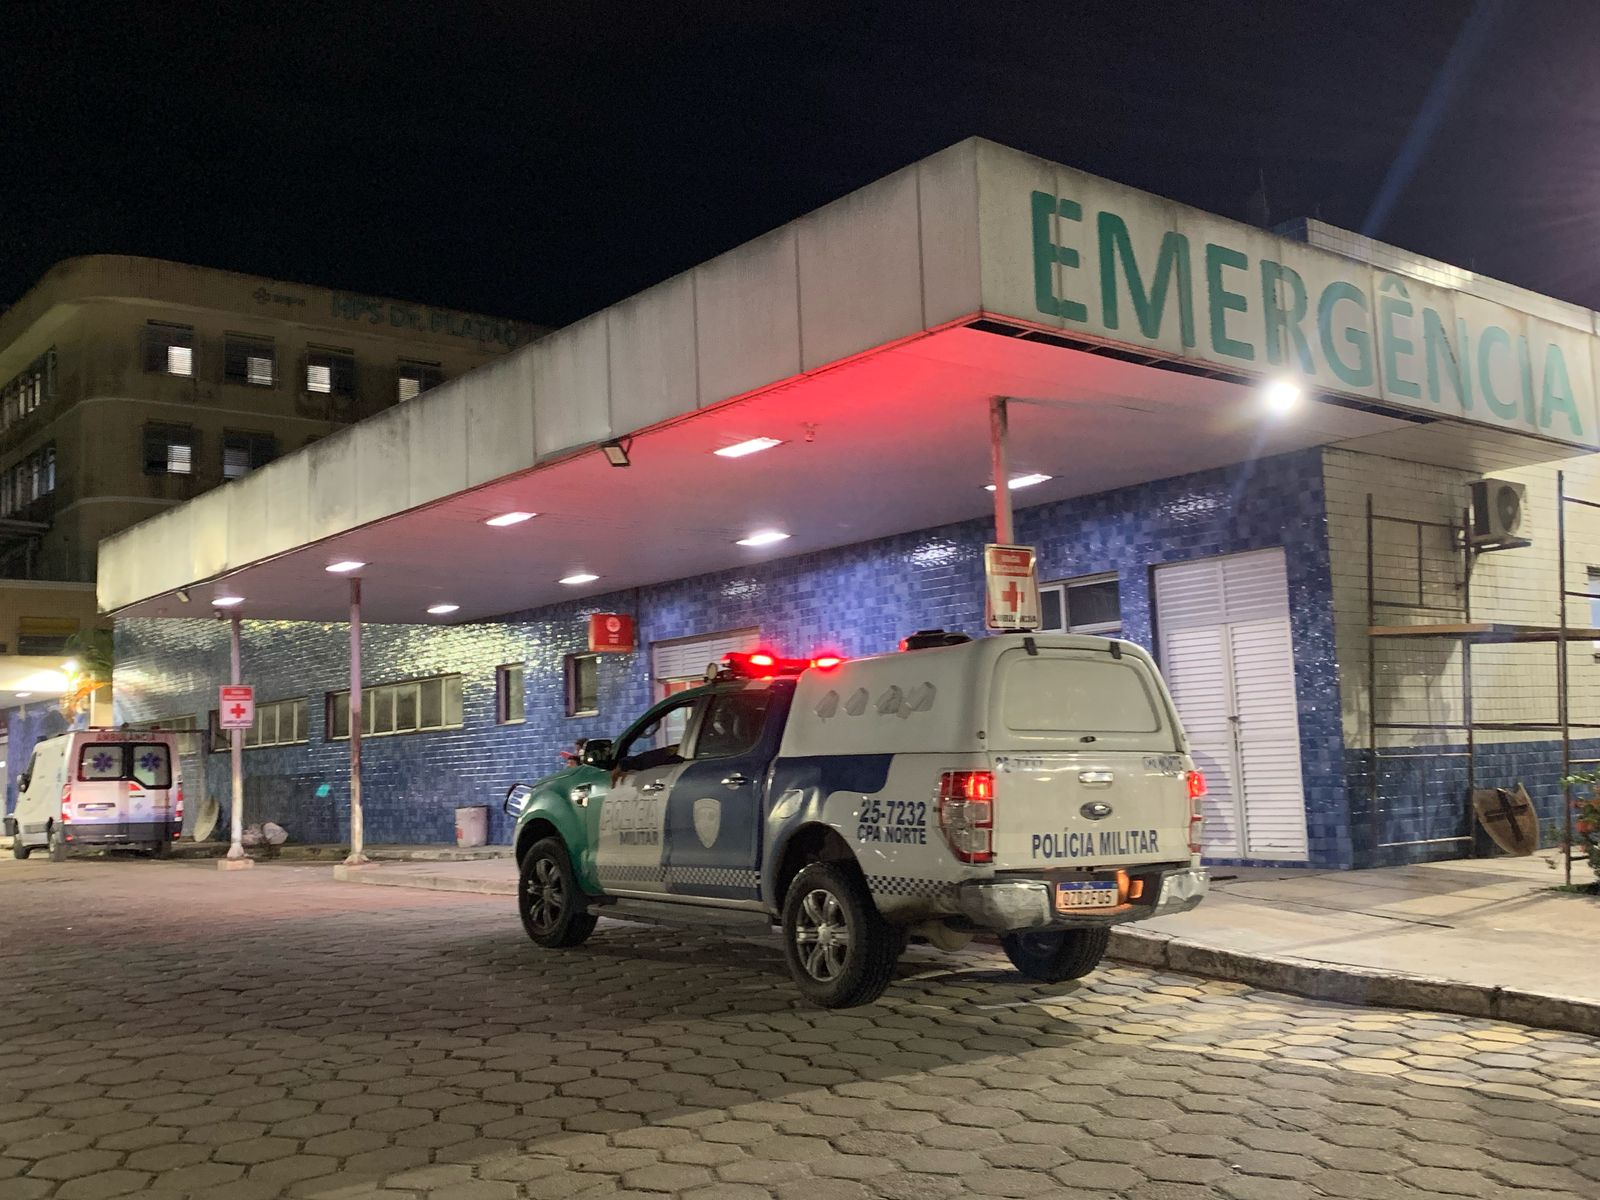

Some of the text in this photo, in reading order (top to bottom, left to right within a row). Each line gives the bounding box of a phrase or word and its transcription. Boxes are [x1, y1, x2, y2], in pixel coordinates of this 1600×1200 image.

[1030, 190, 1583, 436] EMERGÊNCIA
[859, 799, 927, 827] 25-7232
[619, 830, 660, 846] MILITAR
[857, 824, 927, 845] CPA NORTE
[1032, 827, 1160, 859] POLÍCIA MILITAR
